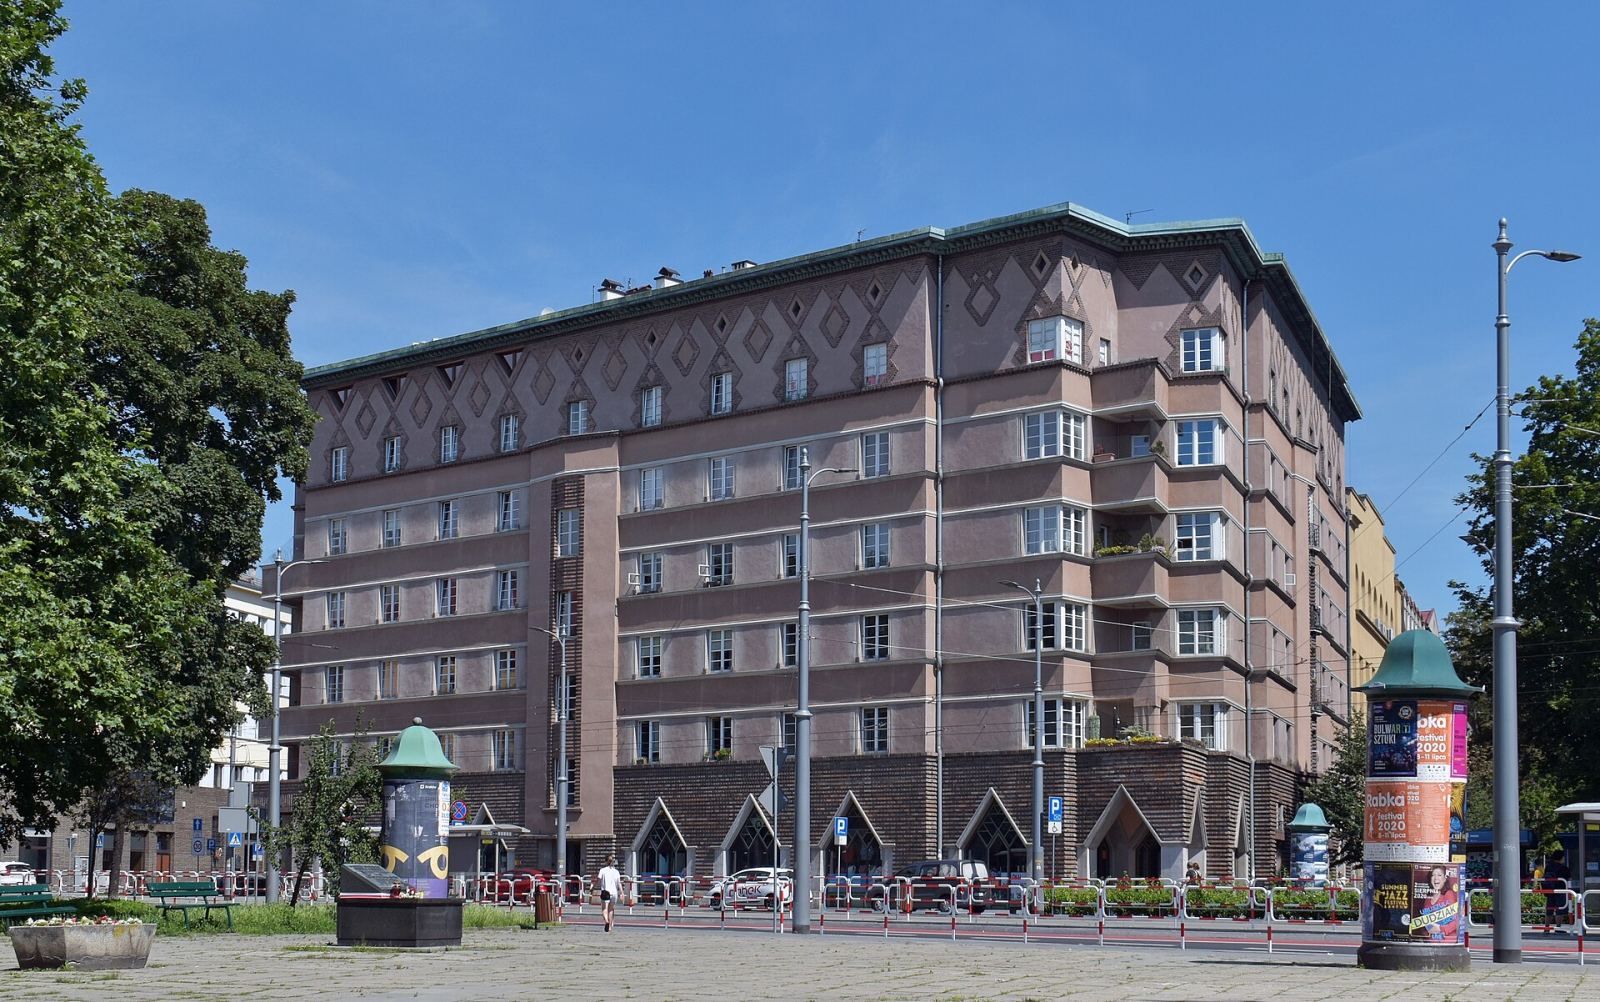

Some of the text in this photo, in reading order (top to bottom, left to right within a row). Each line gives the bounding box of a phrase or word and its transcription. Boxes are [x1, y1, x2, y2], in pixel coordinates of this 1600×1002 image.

[1417, 714, 1447, 729] bka
[1373, 734, 1396, 745] SZTUKI
[1417, 733, 1446, 742] festival
[1417, 743, 1446, 752] 2020
[1366, 792, 1405, 807] Rabka
[1052, 799, 1060, 814] P
[1377, 812, 1405, 820] festival
[837, 819, 845, 833] P
[1378, 821, 1406, 831] 2020
[1390, 832, 1406, 840] lipca
[1384, 890, 1408, 900] JAZZ
[1414, 904, 1456, 927] DUDZIAK
